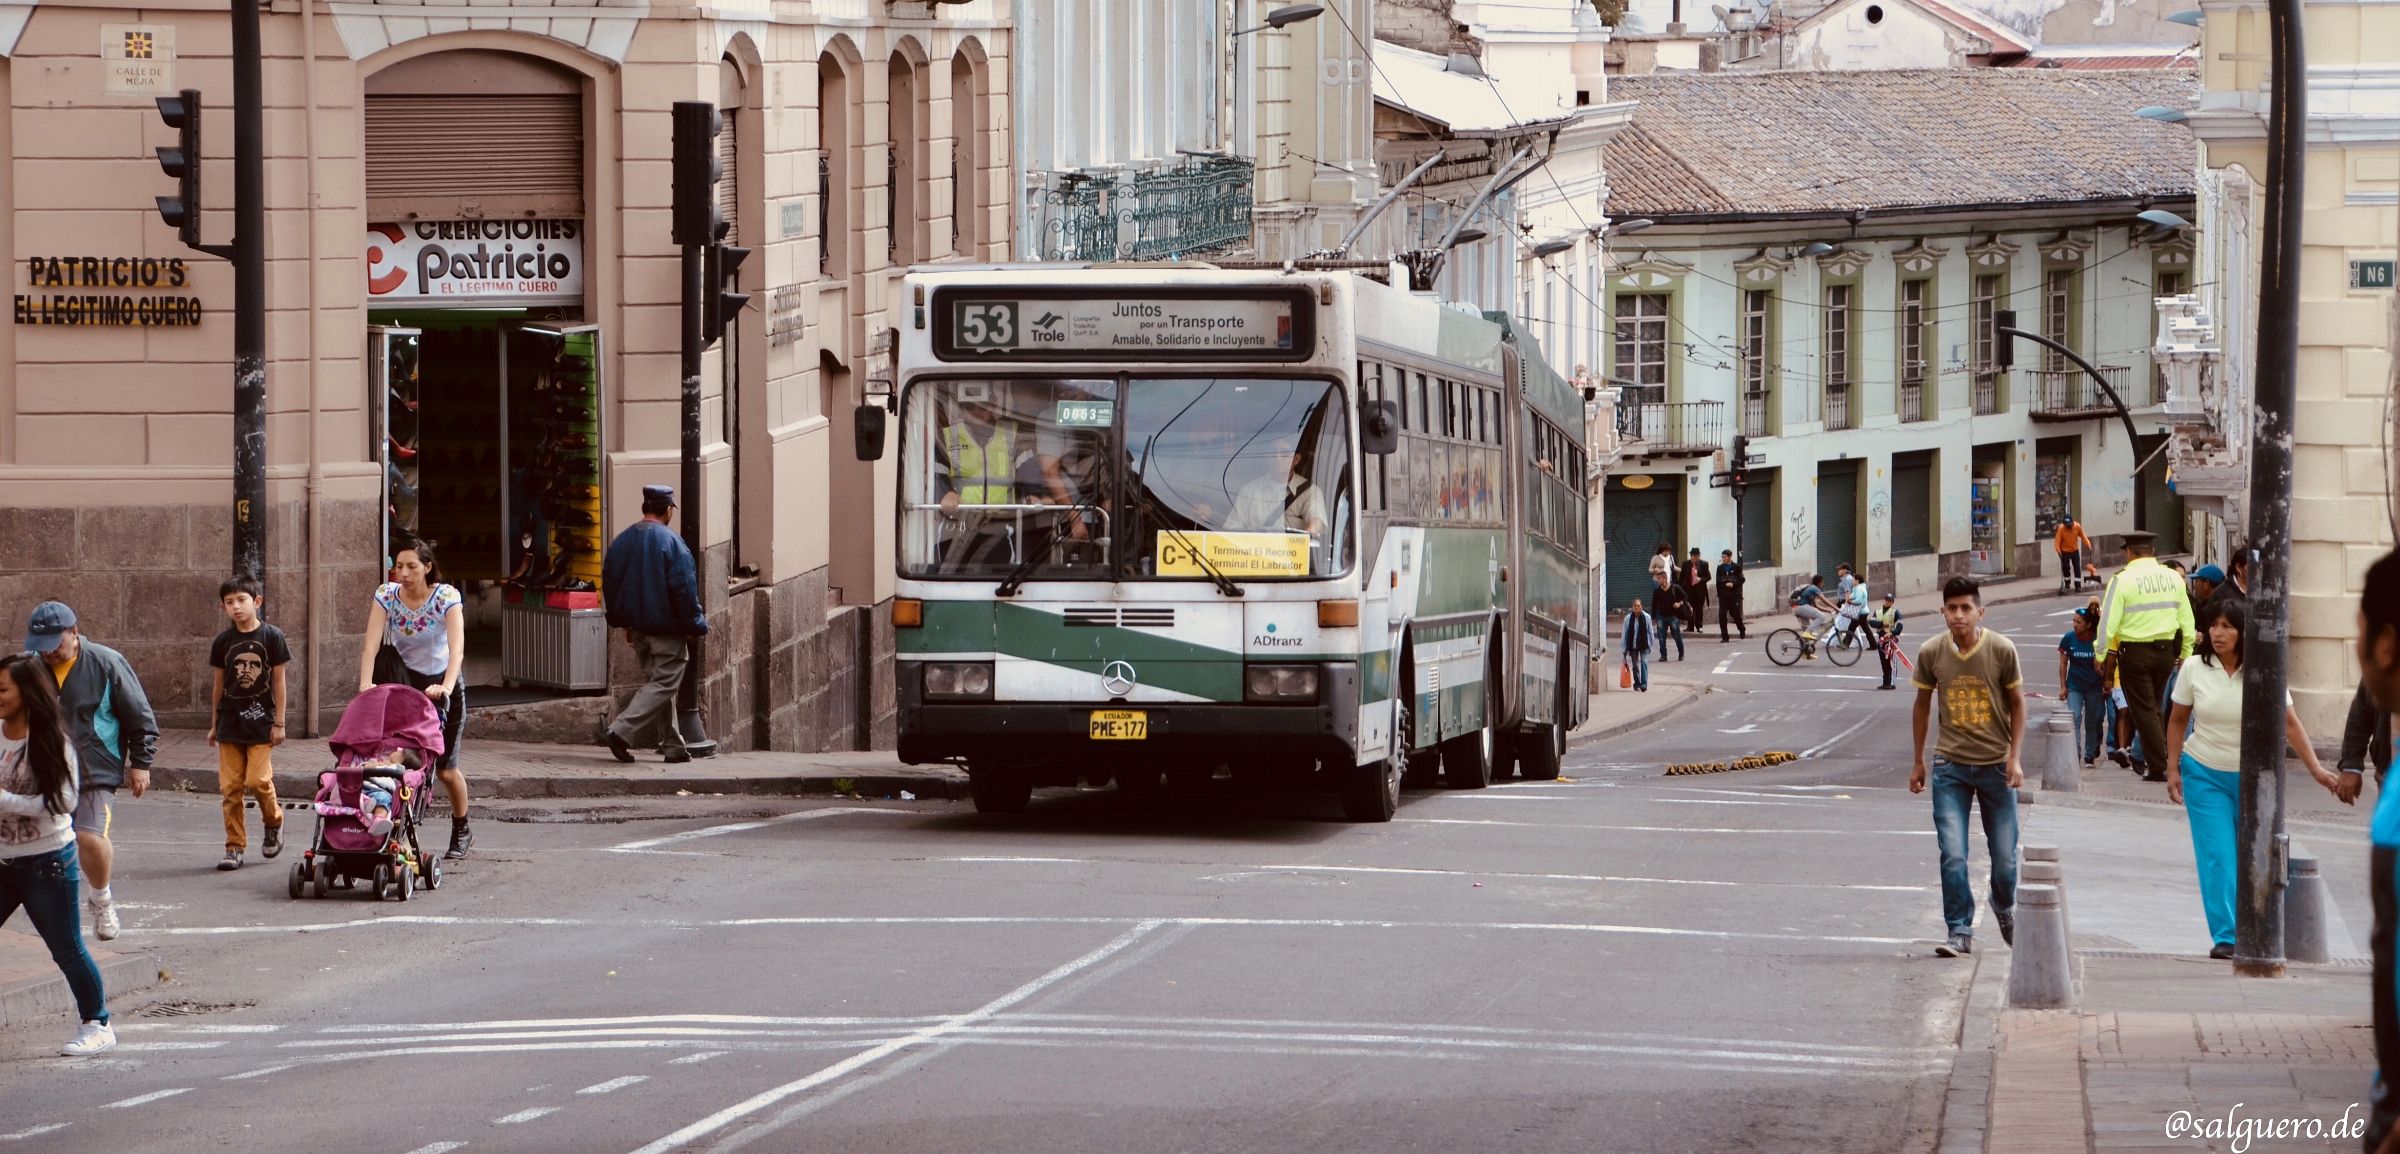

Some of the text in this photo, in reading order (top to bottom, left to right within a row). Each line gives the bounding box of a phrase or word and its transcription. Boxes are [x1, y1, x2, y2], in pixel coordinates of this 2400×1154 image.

[116, 67, 161, 76] CALLE DE
[30, 256, 185, 287] PATRICIO'S
[2367, 266, 2385, 283] N6
[441, 281, 558, 294] EL LEGITIMO CUERO
[14, 294, 202, 326] EL LEGITIMO CUERO
[1112, 302, 1162, 317] Juntos
[963, 305, 1013, 344] 53
[1139, 321, 1154, 330] por
[1169, 314, 1244, 331] Transporte
[1031, 329, 1065, 342] Trole
[1112, 333, 1265, 347] Amable, Solidario e Incluyente
[1062, 407, 1097, 421] 0053
[1162, 545, 1198, 566] C-1
[1213, 545, 1297, 557] Terminal El Recreo
[1210, 558, 1303, 570] Terminal El Labrador
[2136, 573, 2177, 596] POLICIA
[1253, 635, 1303, 646] ADtranz
[1104, 712, 1133, 720] ECUADOR
[1091, 720, 1145, 737] PME-177
